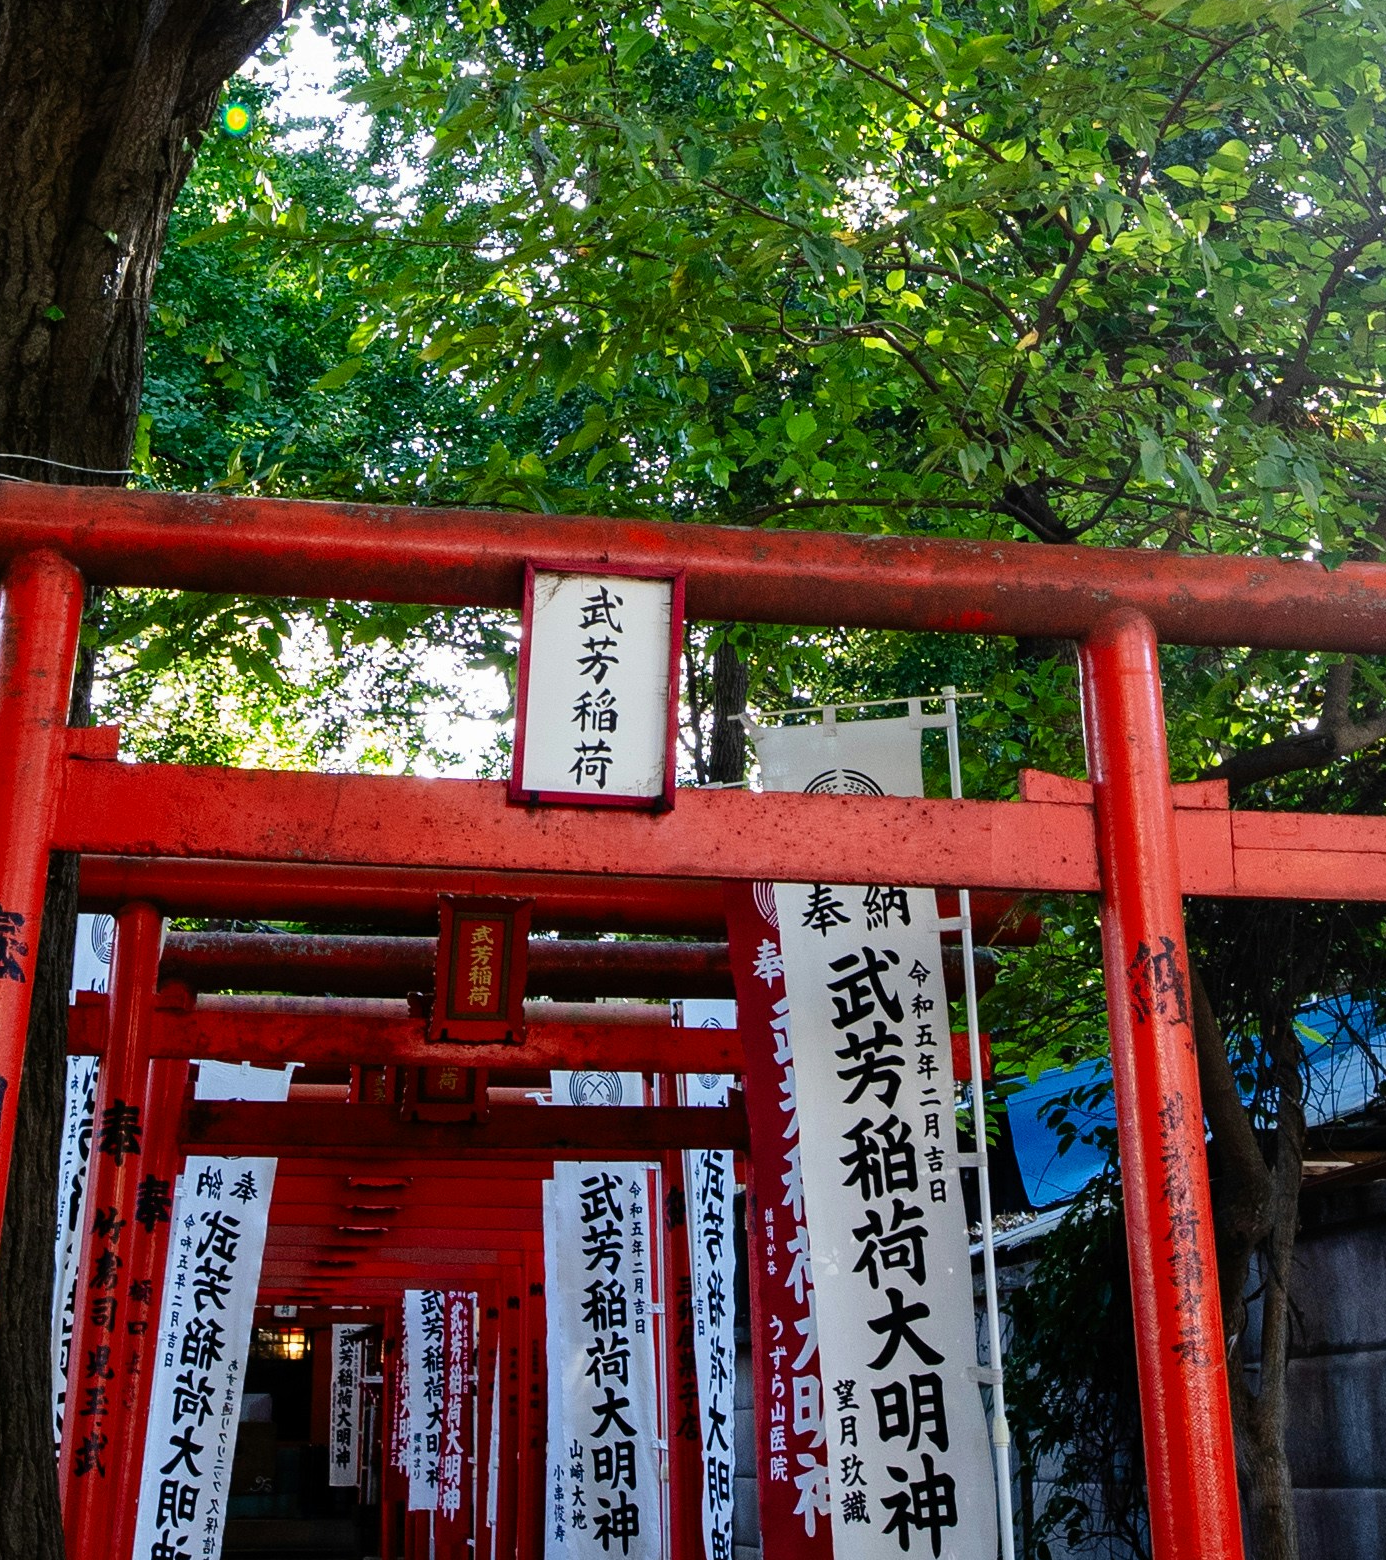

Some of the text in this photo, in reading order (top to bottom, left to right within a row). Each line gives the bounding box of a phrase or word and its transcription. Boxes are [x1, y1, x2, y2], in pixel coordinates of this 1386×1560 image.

[568, 585, 624, 790] 武芳稲荷
[468, 925, 494, 1008] 武芳稲荷
[801, 884, 912, 937] 奉納
[908, 959, 947, 1204] 令和五年二月吉日
[629, 1180, 646, 1335] 令和五年二月吉日
[826, 946, 959, 1560] 武芳稲荷大明神
[578, 1171, 640, 1557] 武芳稲荷大明神
[768, 1314, 788, 1482] うずら山医院
